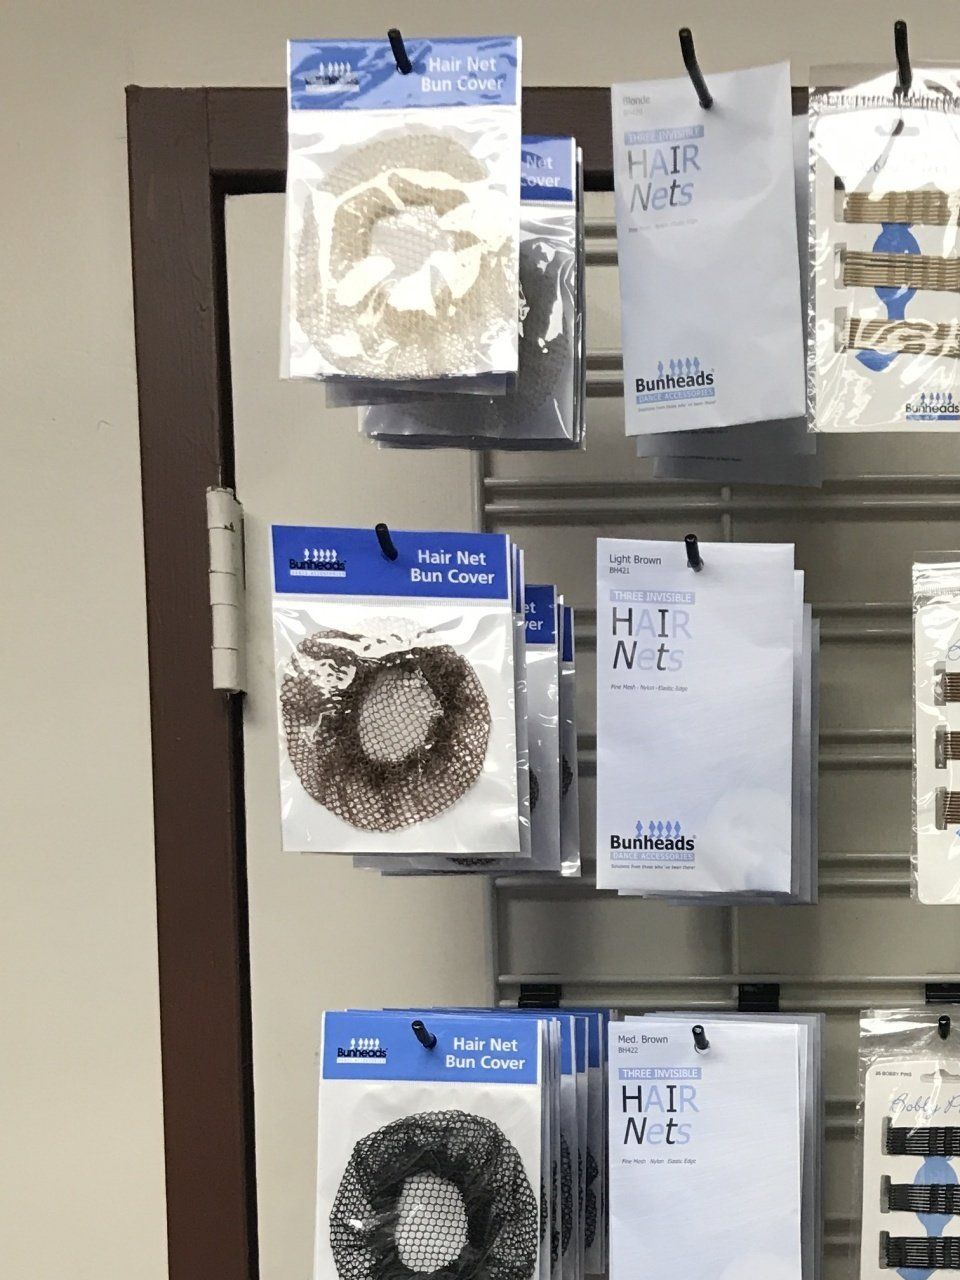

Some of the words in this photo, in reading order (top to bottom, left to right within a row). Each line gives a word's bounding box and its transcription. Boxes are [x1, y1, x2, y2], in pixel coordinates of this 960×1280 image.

[429, 57, 461, 72] Hair
[467, 56, 497, 72] Net
[421, 79, 451, 92] Bun
[457, 76, 504, 91] Cover
[526, 155, 553, 169] Net
[627, 144, 702, 179] HAIR
[630, 179, 695, 213] Nets
[635, 371, 715, 392] Bunheads
[905, 403, 960, 414] Bunheads
[289, 558, 346, 571] Bunheads
[418, 549, 453, 565] Hair
[457, 551, 486, 566] Net
[609, 554, 632, 566] Light
[634, 554, 662, 565] Brown
[411, 568, 443, 583] Bun
[448, 569, 495, 585] Cover
[615, 591, 644, 600] THREE
[646, 592, 692, 602] INVISIBLE
[612, 607, 693, 639] HAIR
[612, 640, 685, 672] Nets
[610, 835, 695, 850] Bunheads
[613, 852, 639, 860] DANCE
[641, 852, 694, 860] ACCESSORIES
[453, 1037, 484, 1051] Hair
[490, 1038, 518, 1052] Net
[618, 1035, 639, 1044] Med.
[641, 1035, 668, 1044] Brown
[337, 1048, 387, 1058] Bunheads
[445, 1055, 475, 1068] Bun
[480, 1055, 526, 1070] Cover
[623, 1069, 652, 1078] THREE
[654, 1069, 698, 1078] INVISIBLE
[622, 1085, 700, 1113] HAIR
[623, 1116, 692, 1145] Nets
